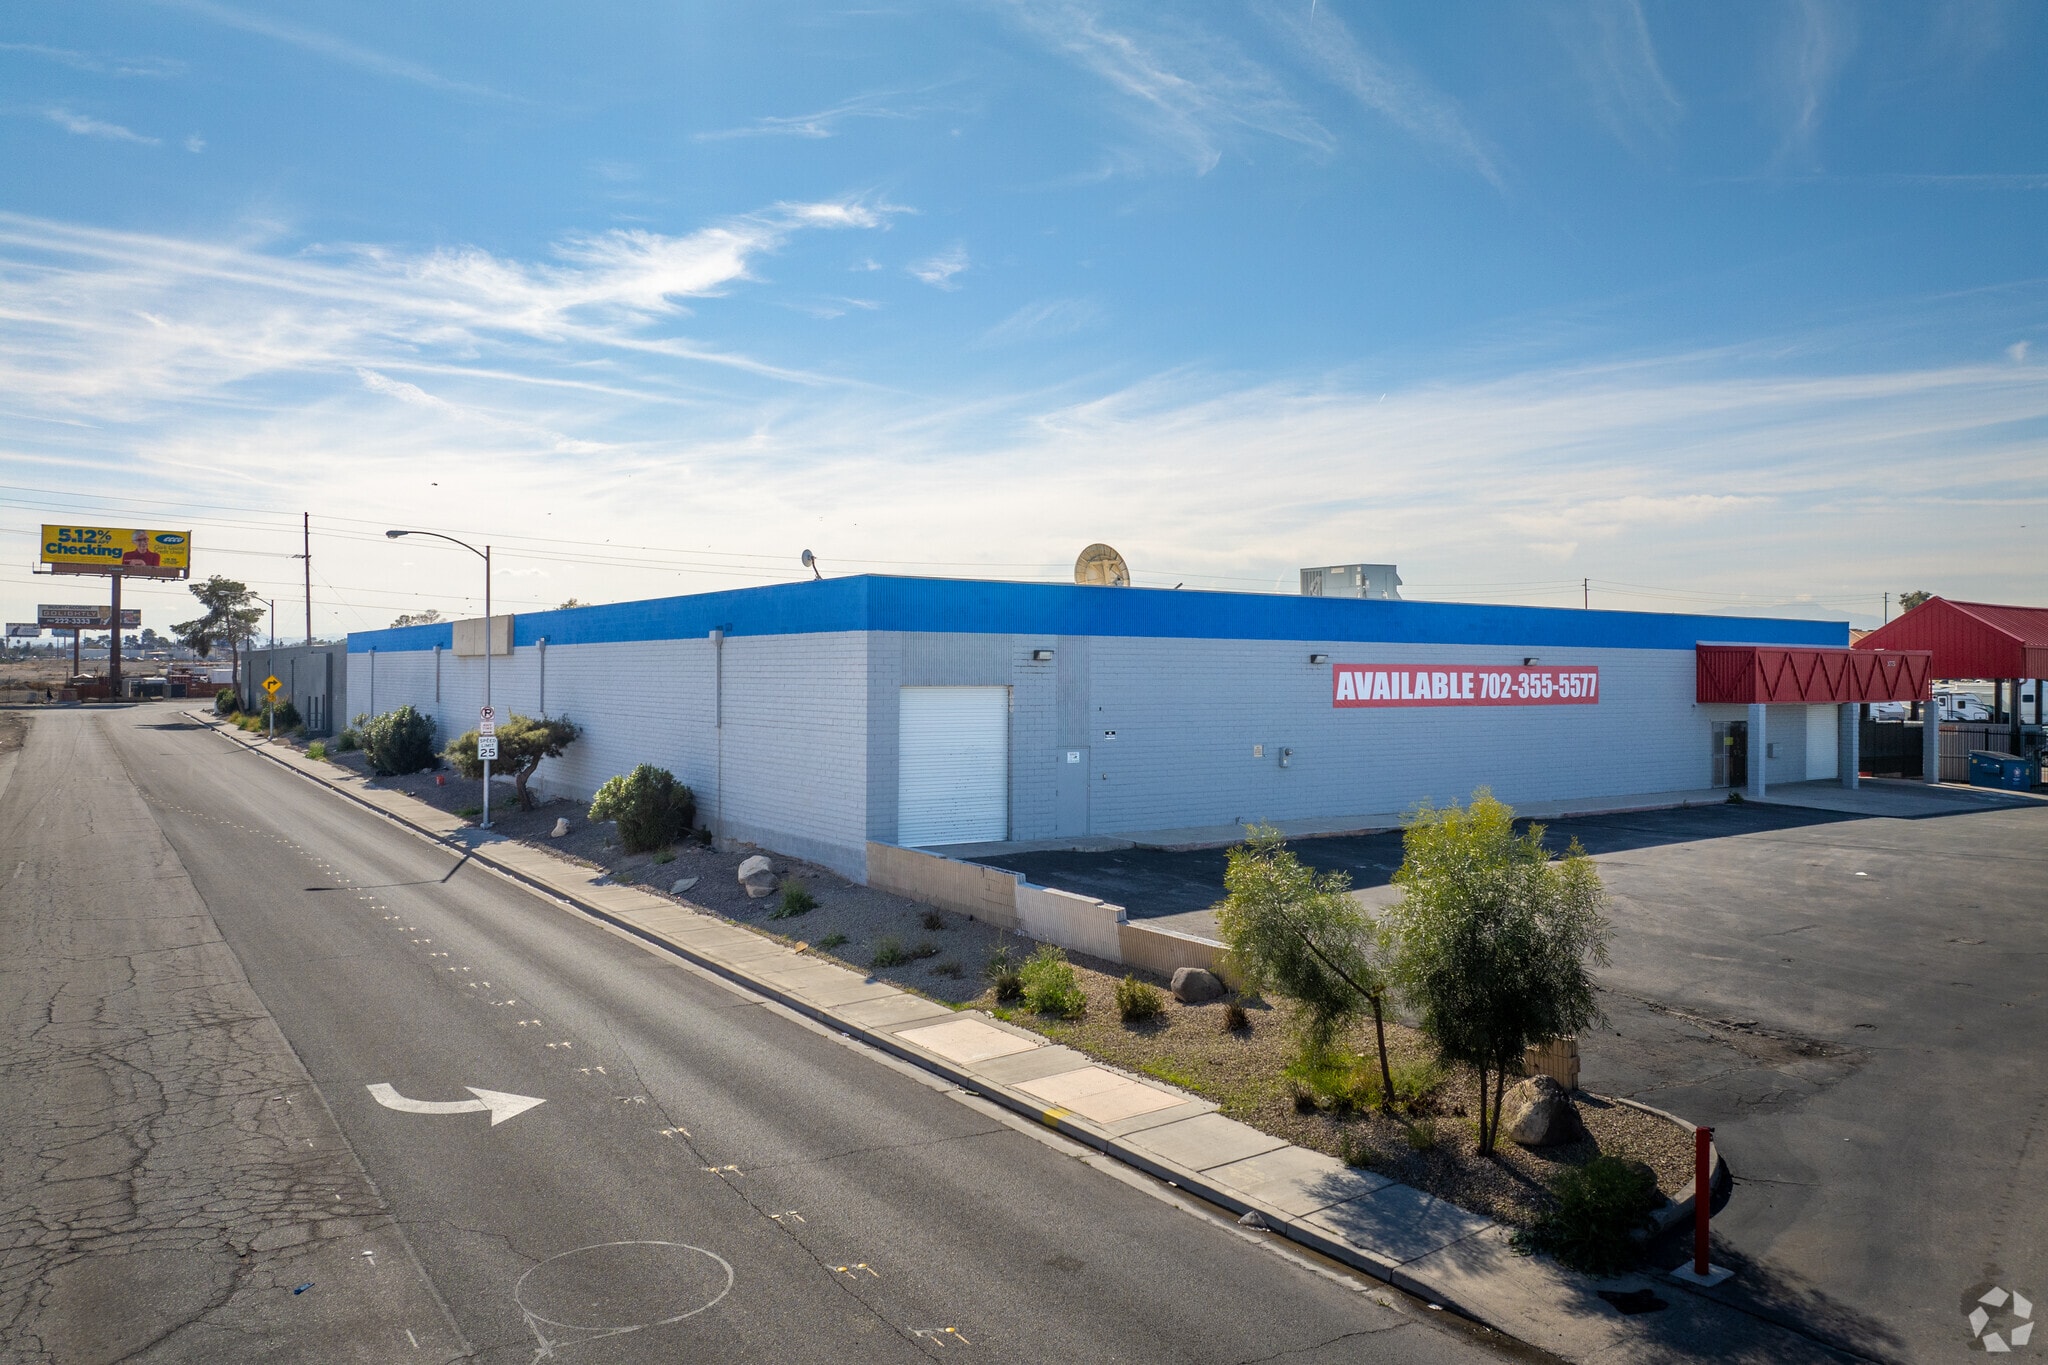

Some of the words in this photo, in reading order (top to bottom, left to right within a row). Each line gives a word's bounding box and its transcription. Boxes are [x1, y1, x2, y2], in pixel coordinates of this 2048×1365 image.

[58, 528, 112, 543] 5.12%
[45, 542, 122, 558] Checking
[1336, 671, 1474, 700] AVAILABLE
[1478, 673, 1597, 699] 702-355-5577
[480, 748, 495, 757] 25
